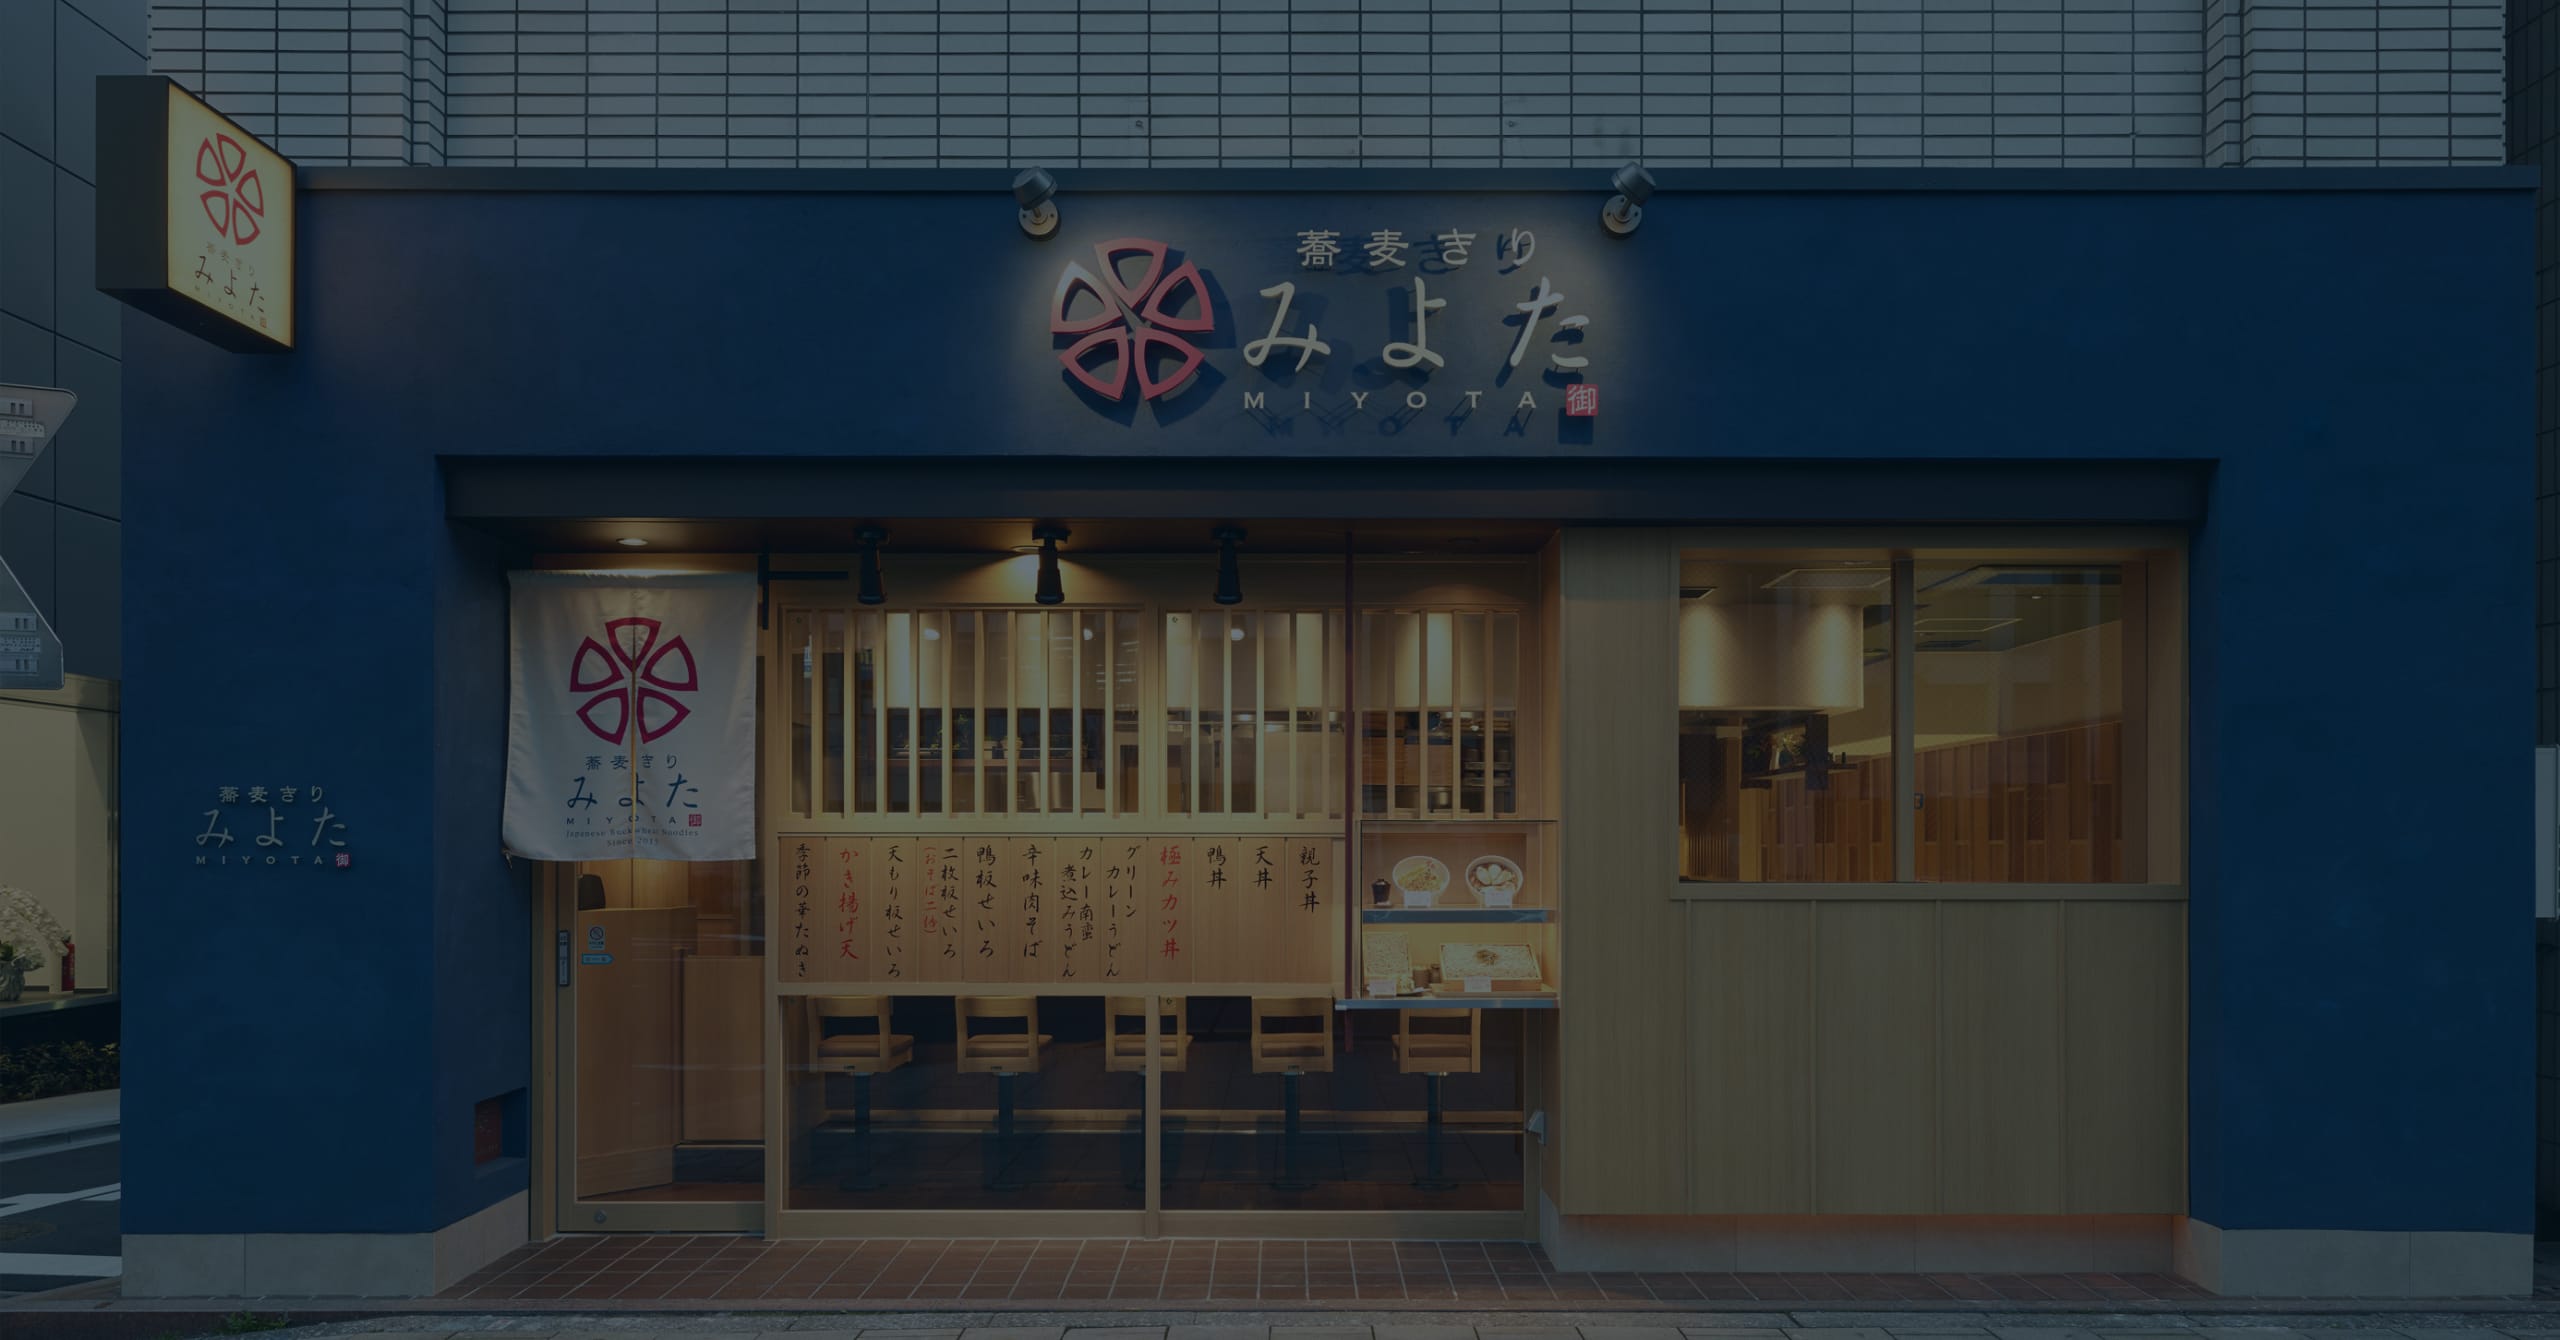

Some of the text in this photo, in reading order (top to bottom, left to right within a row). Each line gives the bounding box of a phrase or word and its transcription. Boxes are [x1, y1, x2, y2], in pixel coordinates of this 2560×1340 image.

[1297, 228, 1536, 268] 蕎麦きり
[195, 256, 265, 313] みよた
[1244, 276, 1590, 373] みよた
[1244, 390, 1537, 409] MIYOTA
[1567, 385, 1597, 416] 御
[585, 754, 677, 770] 蕎麦きり
[218, 785, 324, 803] 蕎麦きり
[567, 772, 699, 809] みよた
[195, 806, 347, 848] みよた
[566, 815, 677, 826] MIYOTA
[196, 855, 323, 865] MIYOTA
[1127, 845, 1141, 918] グリーン
[1255, 846, 1273, 889] 天丼
[1300, 846, 1320, 912] 親子丼
[839, 848, 859, 959] かき揚げ天
[1022, 845, 1043, 958] 辛味肉そば
[1080, 846, 1094, 940] カレー南蛮
[1160, 845, 1181, 960] 極みカツ丼
[1060, 864, 1078, 978] 煮込みうどん
[1107, 865, 1121, 978] カレーうどん
